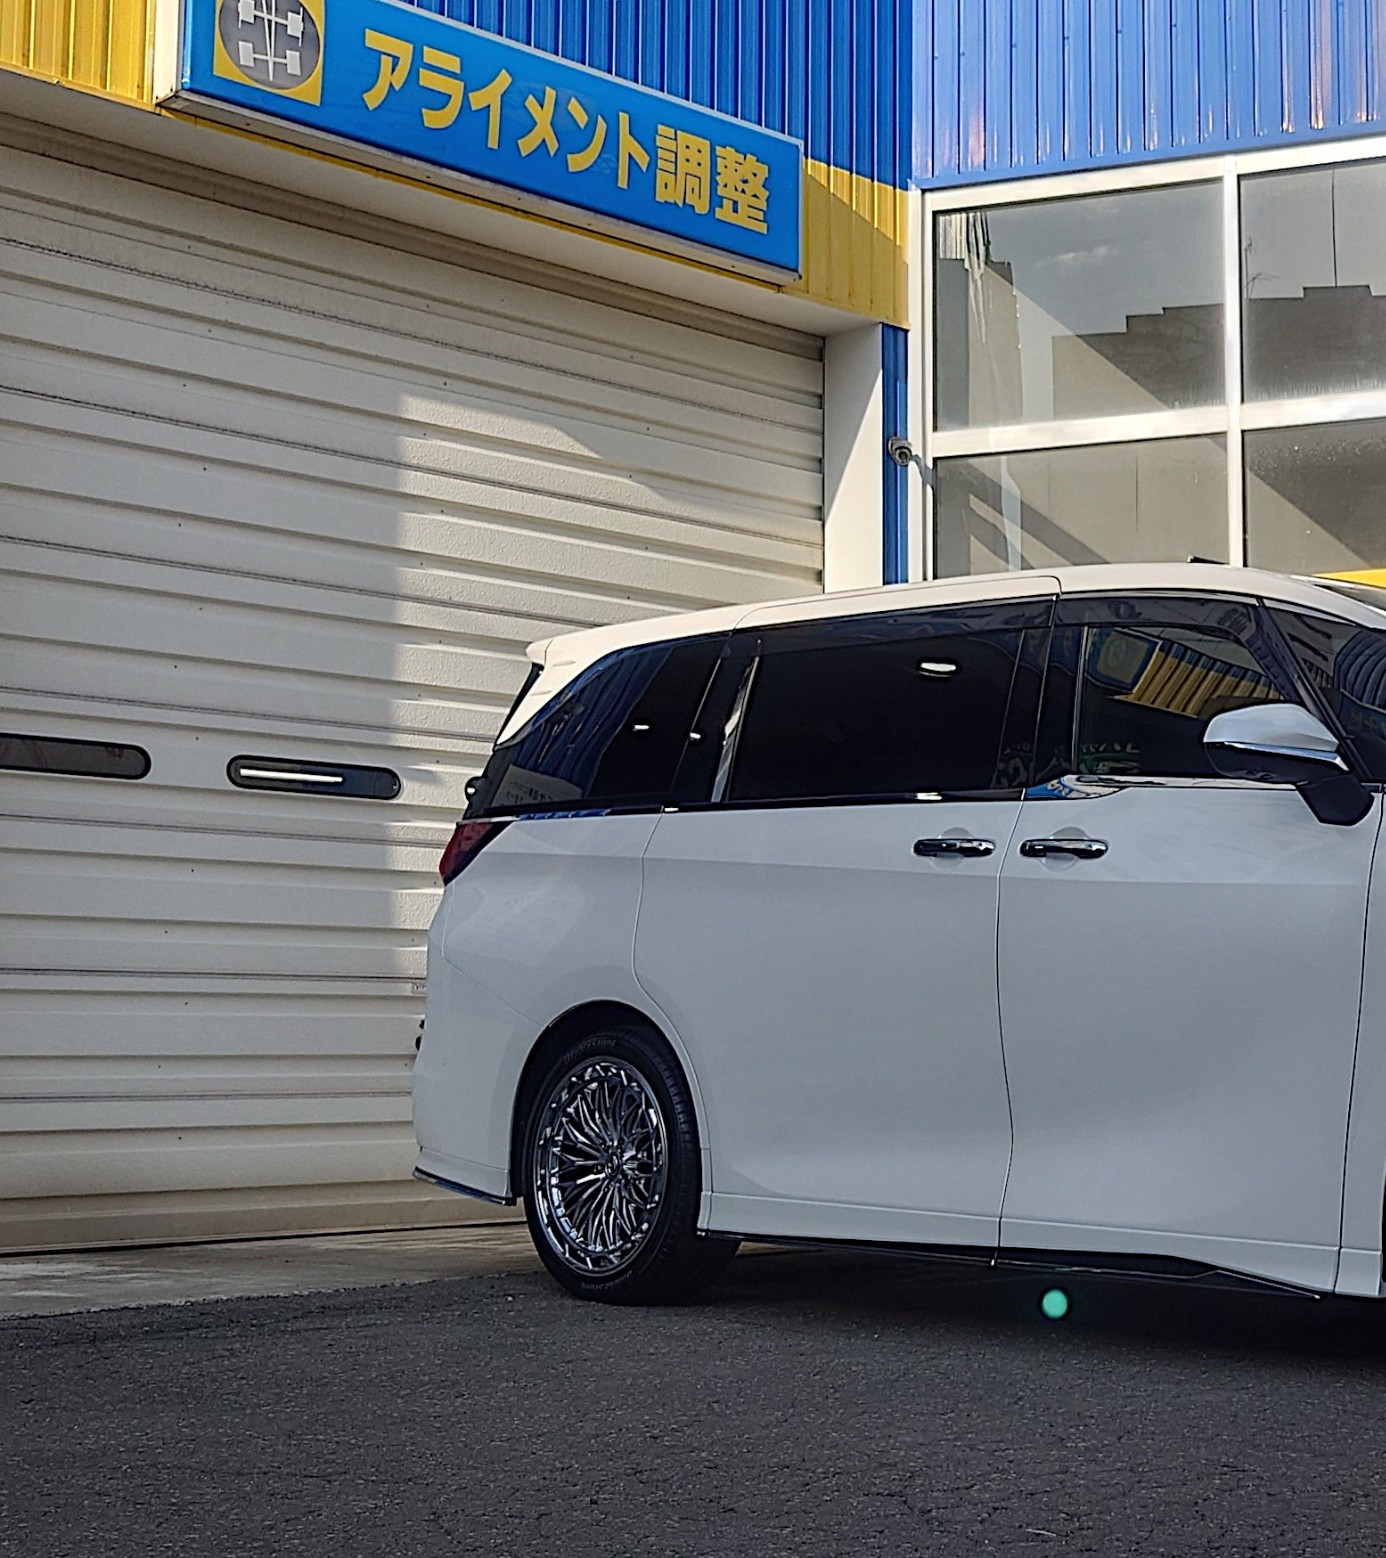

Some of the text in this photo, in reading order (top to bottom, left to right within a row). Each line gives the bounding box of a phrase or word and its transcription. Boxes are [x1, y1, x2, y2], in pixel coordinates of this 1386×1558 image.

[362, 28, 769, 235] アライメント調整
